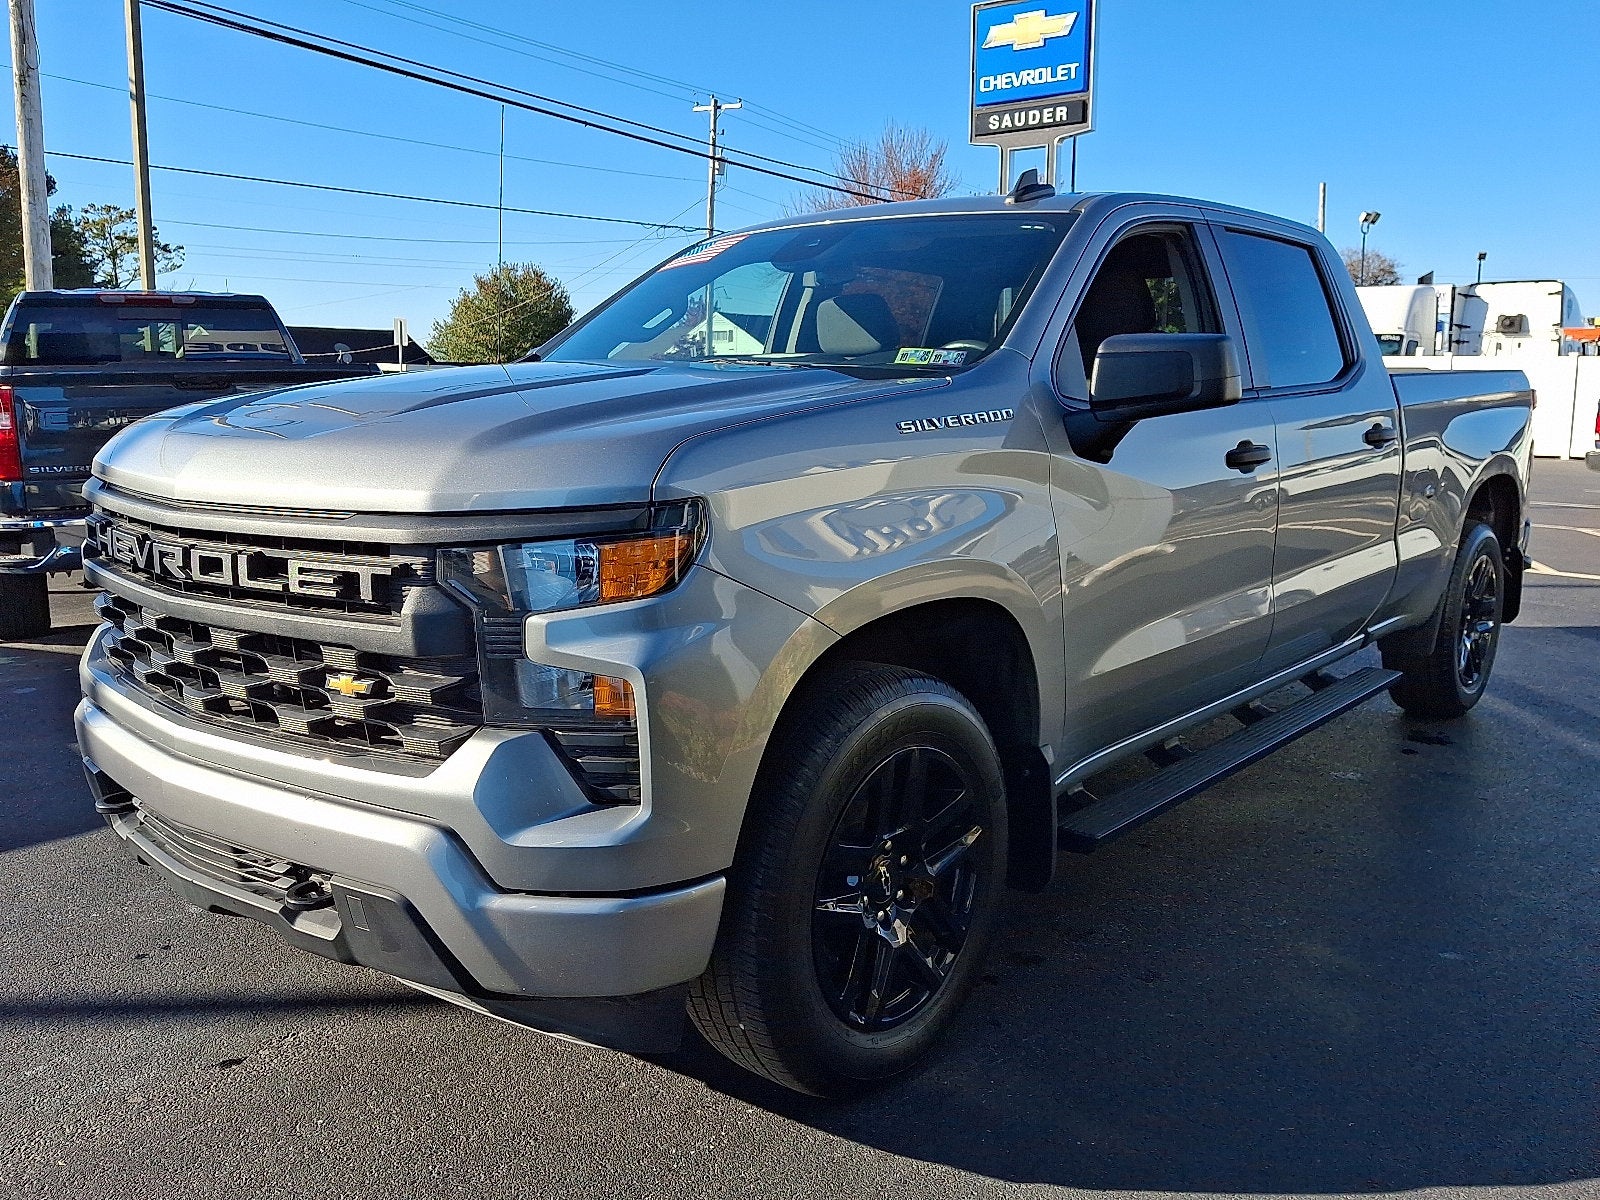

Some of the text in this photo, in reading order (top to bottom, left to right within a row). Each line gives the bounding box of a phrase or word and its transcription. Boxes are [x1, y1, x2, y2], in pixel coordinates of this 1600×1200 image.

[979, 63, 1079, 92] CHEVROLET
[988, 106, 1067, 130] SAUDER
[897, 408, 1014, 434] SILVERADO
[85, 514, 393, 604] CHEVROLET
